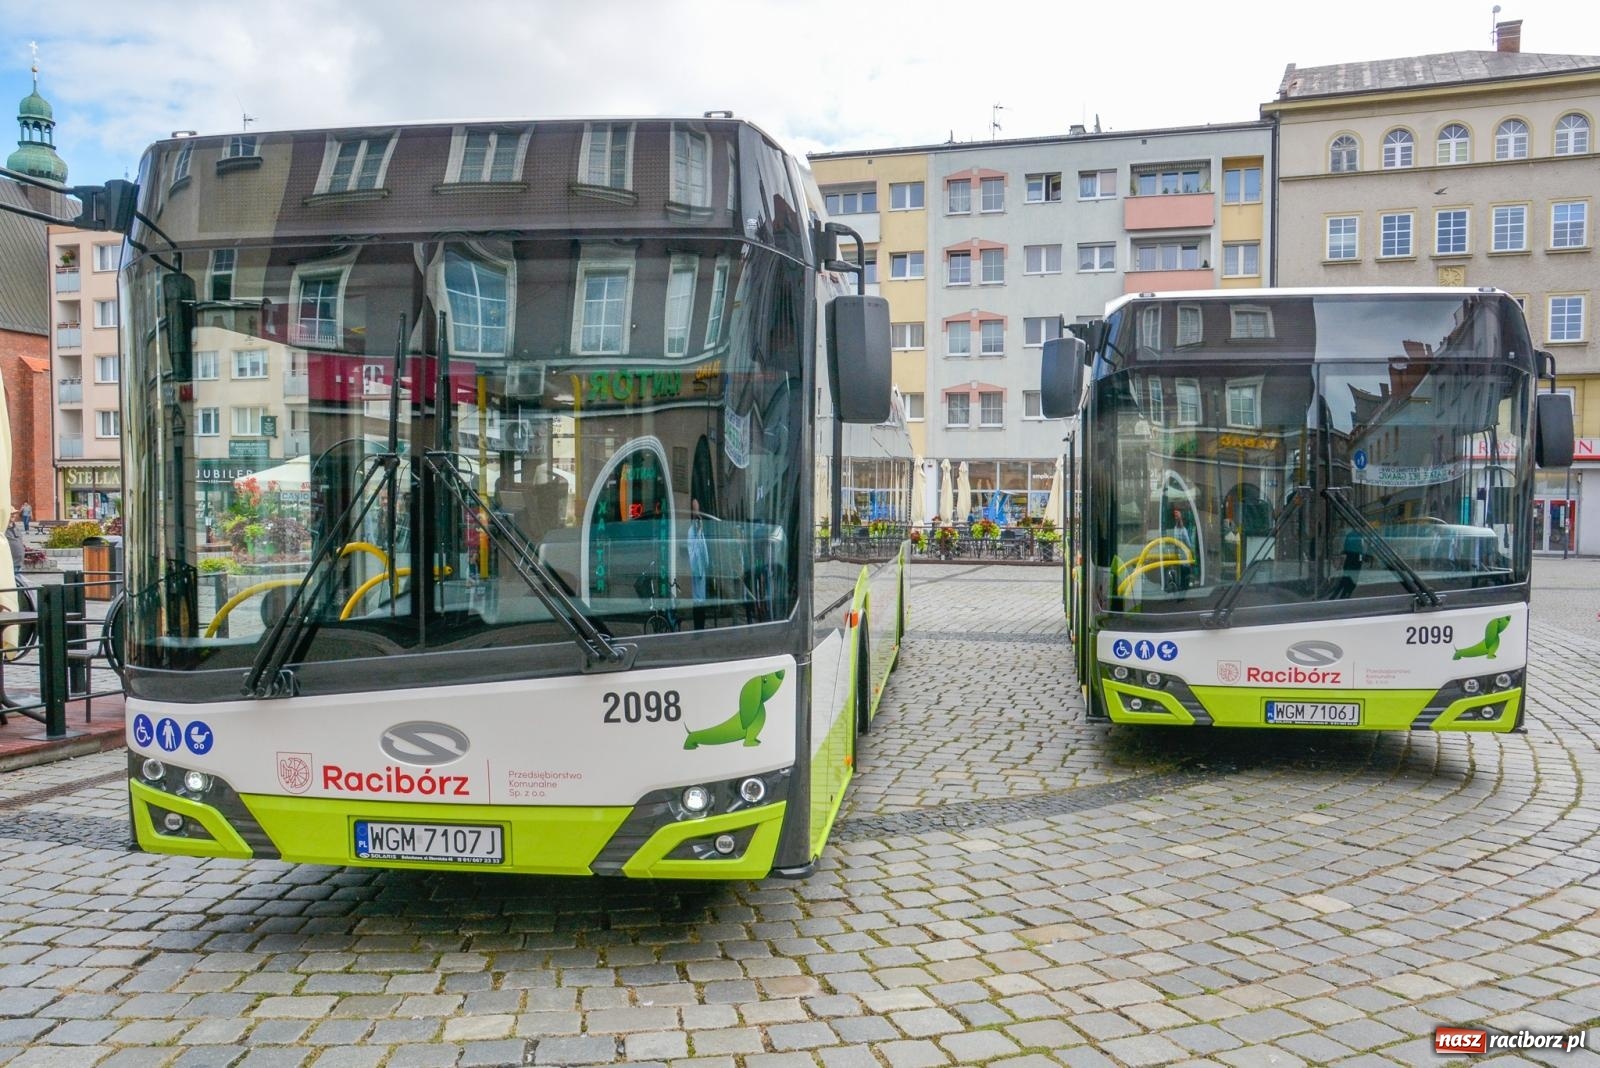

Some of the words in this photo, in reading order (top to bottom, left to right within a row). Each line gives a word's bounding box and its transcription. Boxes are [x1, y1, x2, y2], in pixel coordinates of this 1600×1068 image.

[1406, 625, 1453, 644] 2099
[1247, 667, 1341, 684] Racibórz
[603, 690, 681, 723] 2098
[1276, 704, 1304, 719] WGM
[1310, 705, 1355, 720] 7106J
[322, 765, 470, 796] Racibórz
[508, 770, 583, 780] Przedsiębiorstwo
[508, 780, 557, 788] Komunalne
[358, 840, 368, 848] PL
[370, 826, 416, 852] WGM
[424, 828, 496, 855] 7107J
